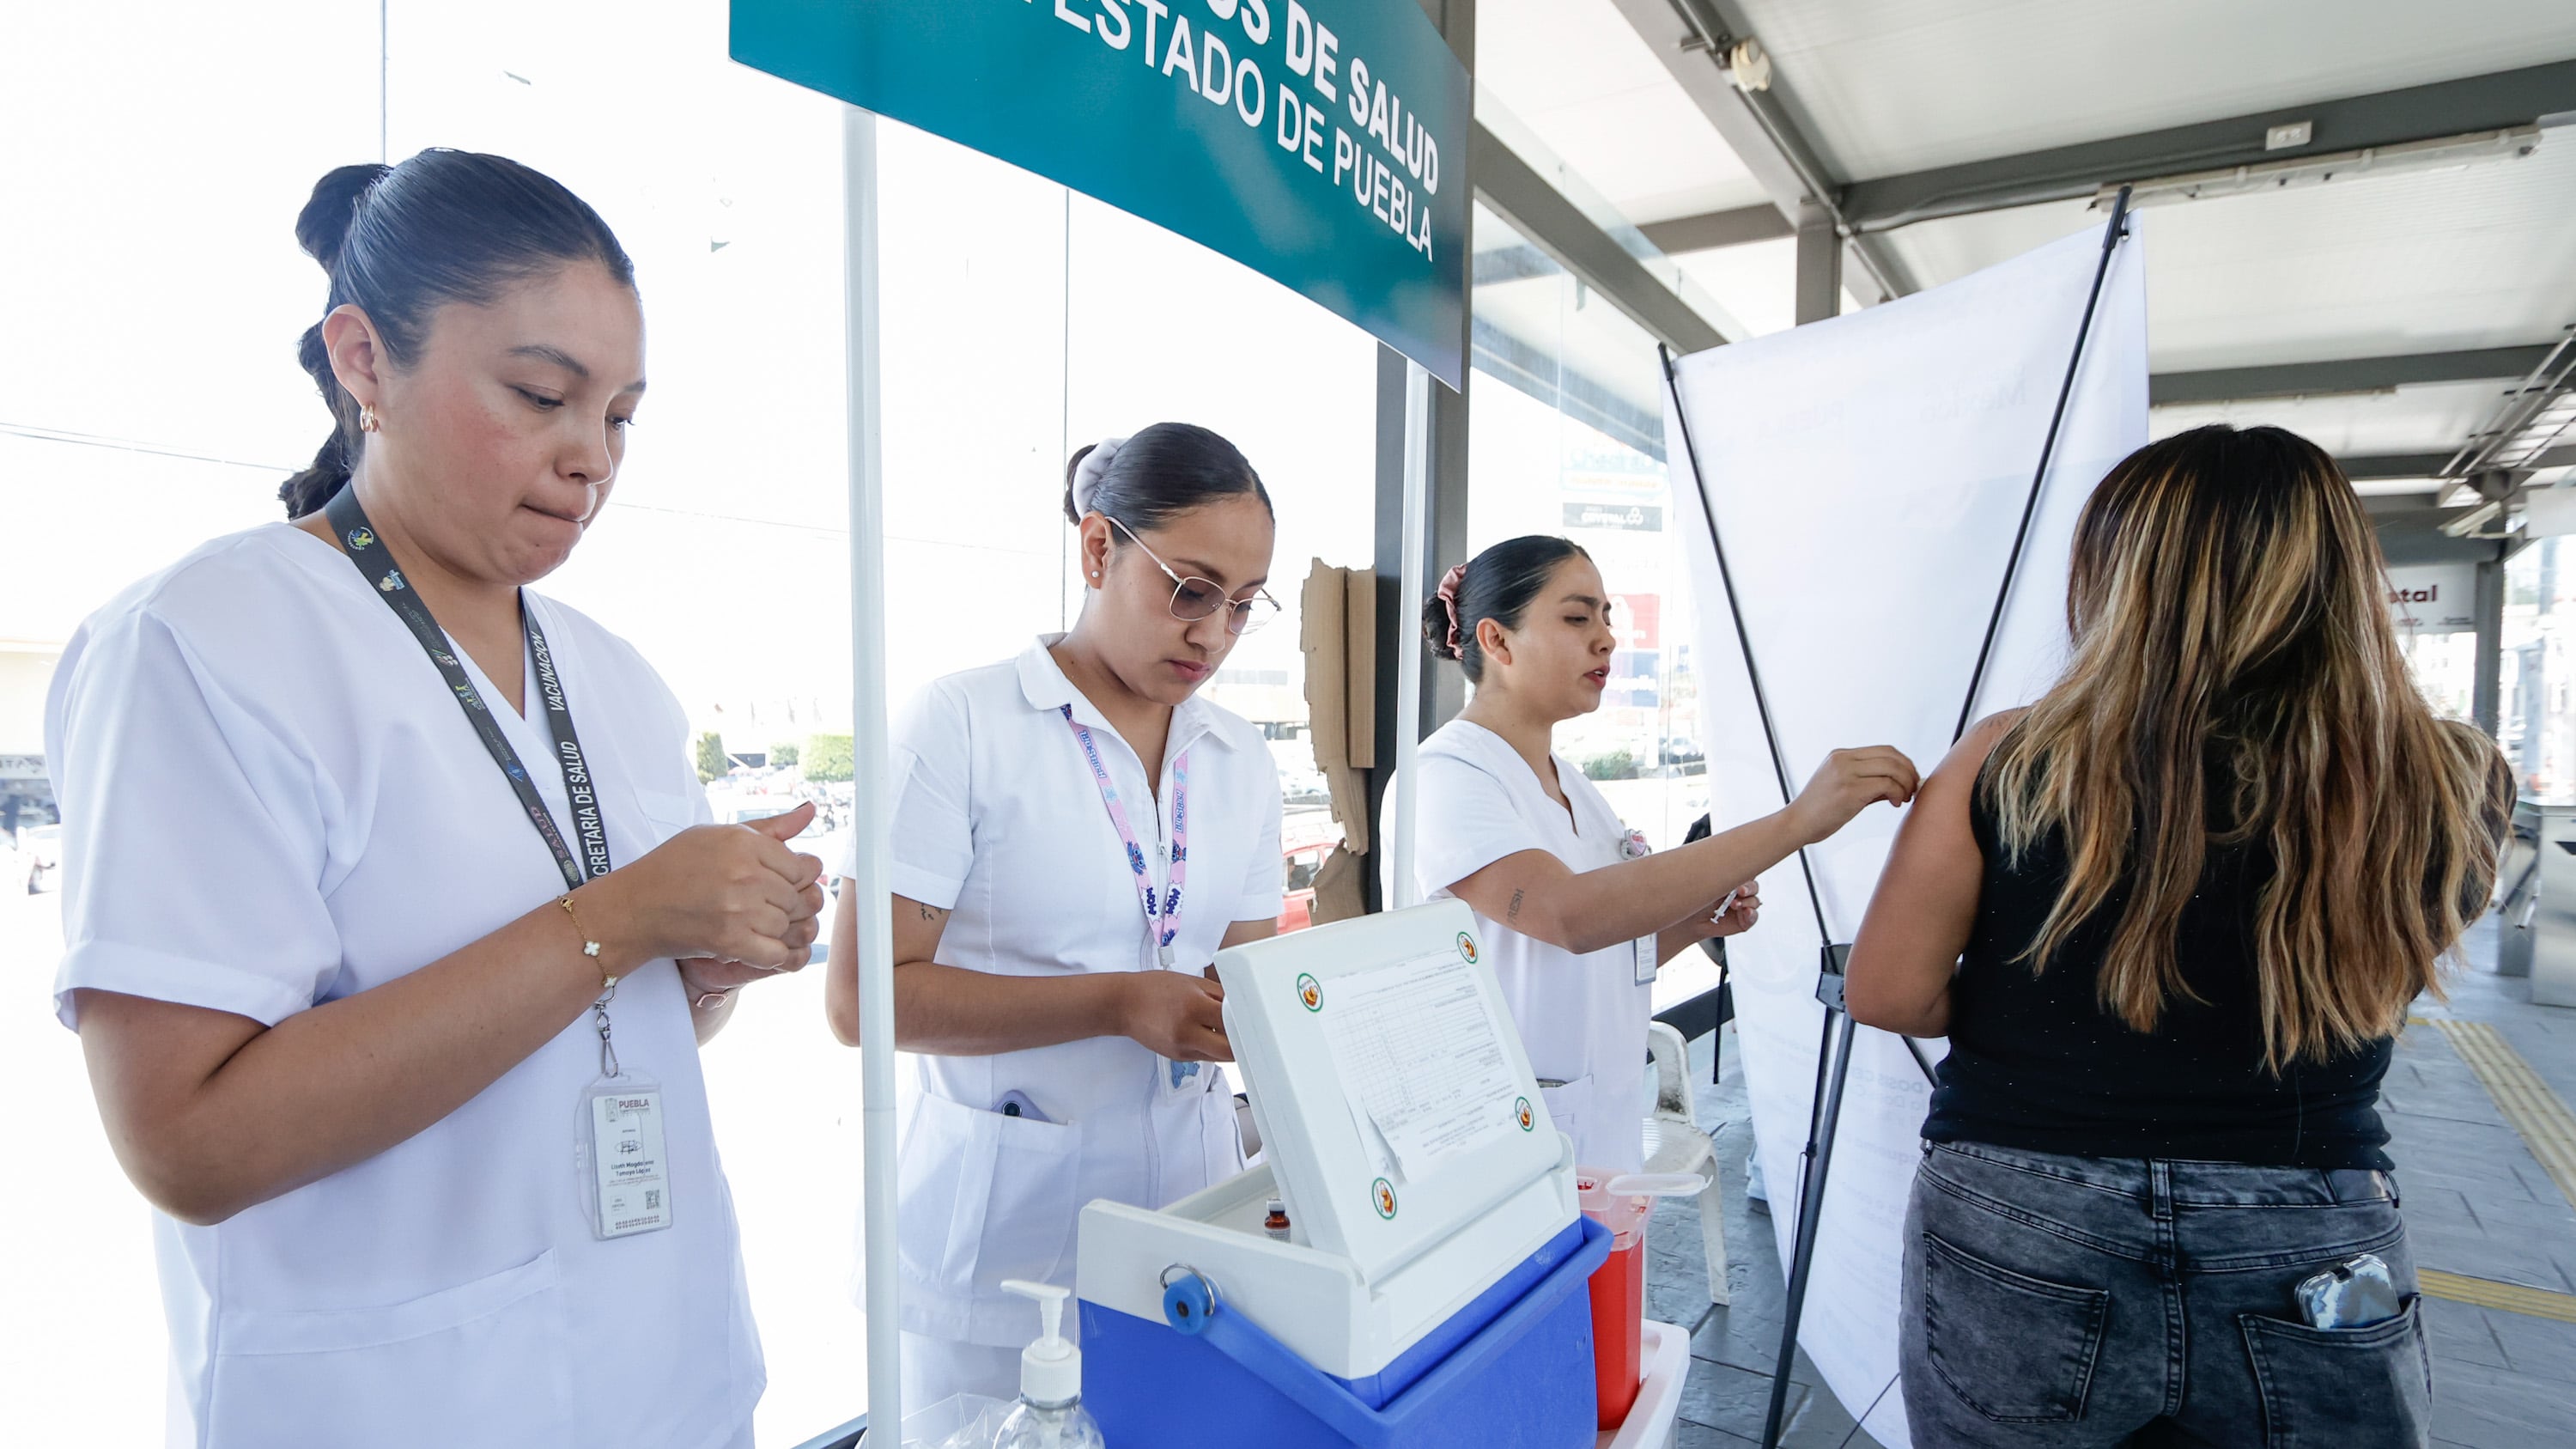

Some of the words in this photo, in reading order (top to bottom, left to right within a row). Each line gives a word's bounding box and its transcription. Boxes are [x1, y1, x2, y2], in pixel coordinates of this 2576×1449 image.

[1285, 1, 1340, 104] DE
[1347, 57, 1439, 196] SALUD
[1277, 82, 1326, 174] DE
[1334, 127, 1434, 263] PUEBLA
[531, 630, 566, 712] VACUNACION
[560, 741, 588, 784] SALUD
[574, 785, 591, 804] DE
[618, 1099, 650, 1109] PUEBLA
